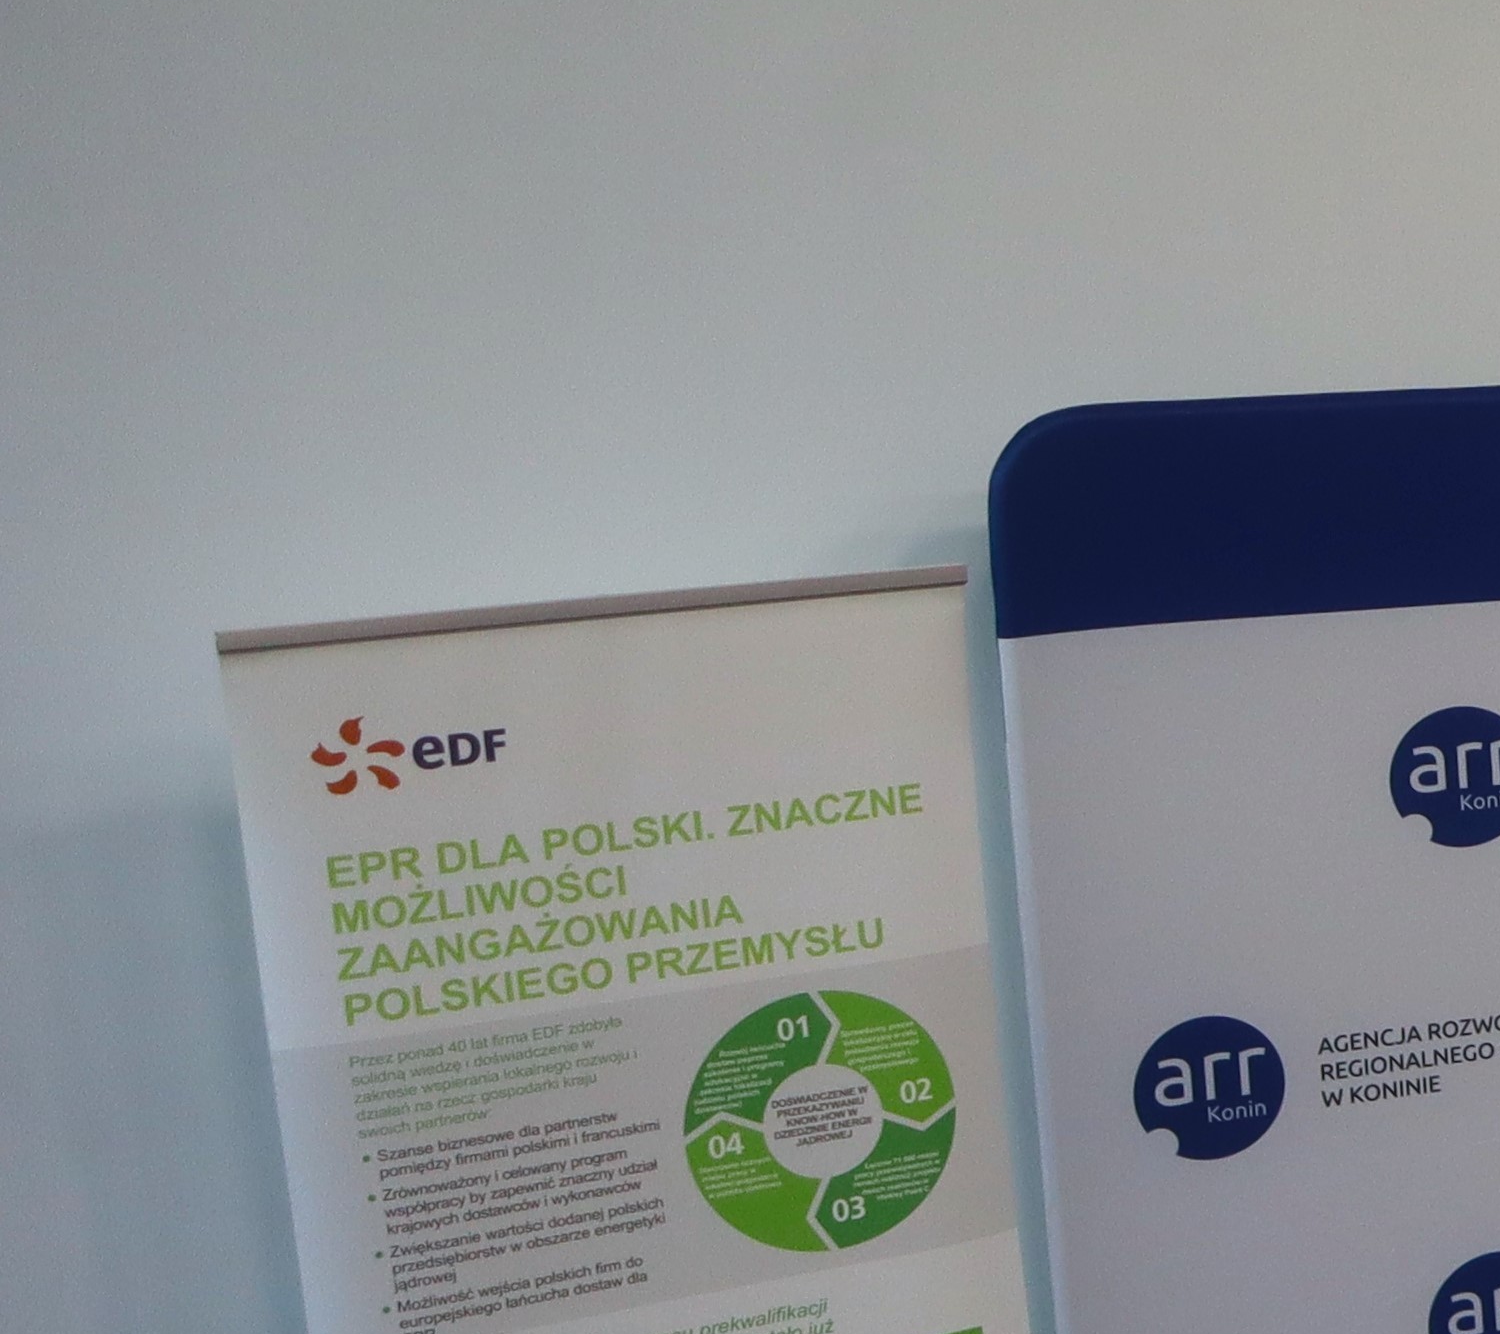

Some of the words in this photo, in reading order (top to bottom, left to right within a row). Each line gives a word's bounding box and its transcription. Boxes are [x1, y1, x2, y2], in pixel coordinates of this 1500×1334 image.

[325, 848, 422, 889] EPR
[438, 835, 530, 877] DLA
[541, 810, 716, 863] POLSKI.
[727, 783, 925, 840] ZNACZNE
[331, 863, 629, 936] MOŻLIWOŚCI
[336, 893, 744, 982] ZAANGAŻOWANIA
[342, 959, 613, 1026] POLSKIEGO
[627, 917, 886, 986] PRZEMYSŁU
[777, 1015, 810, 1042] 01
[1318, 1028, 1423, 1055] AGENCJA
[1154, 1047, 1266, 1108] arr
[1320, 1042, 1495, 1082] REGIONALNEGO
[900, 1077, 933, 1104] 02
[1321, 1090, 1343, 1108] W
[1349, 1075, 1442, 1104] KONINIE
[1207, 1102, 1267, 1123] Konin
[708, 1132, 745, 1159] 04
[832, 1195, 866, 1222] 03
